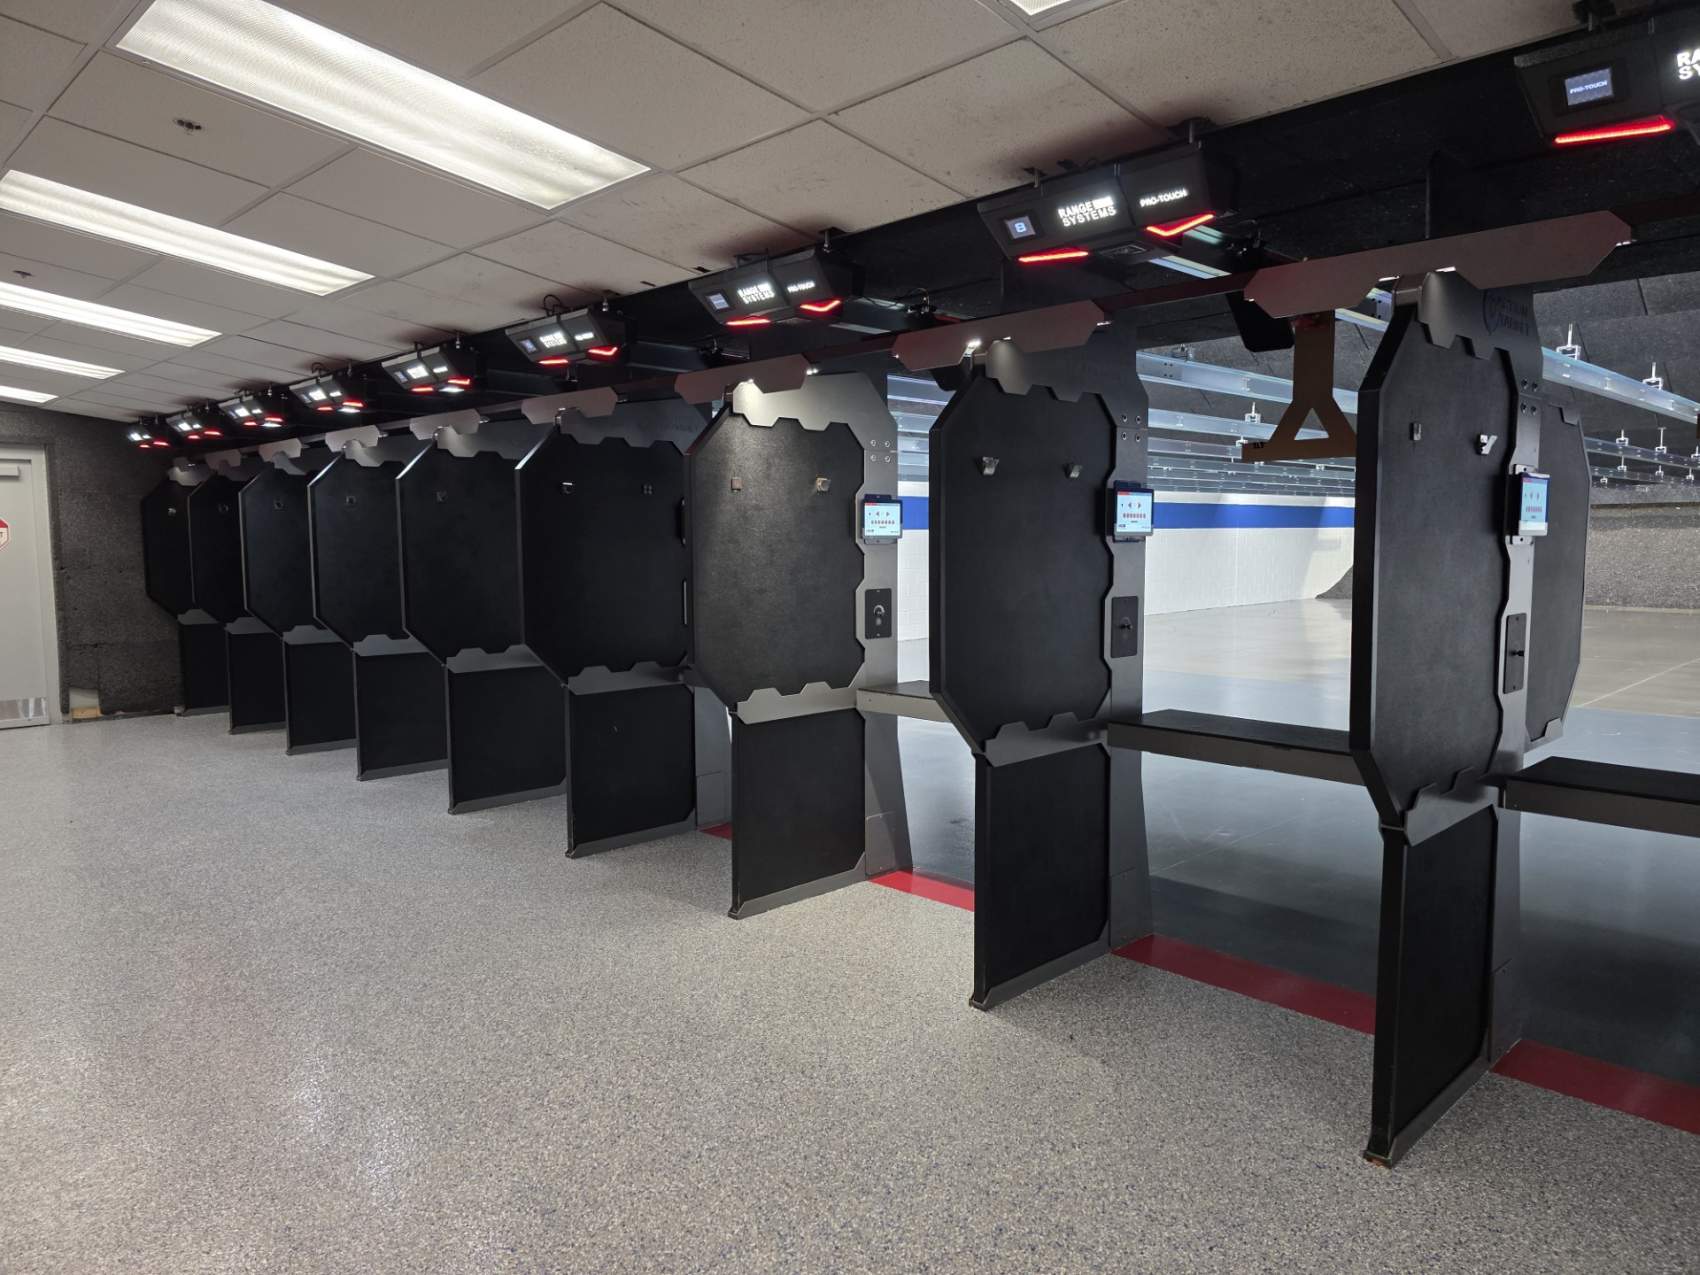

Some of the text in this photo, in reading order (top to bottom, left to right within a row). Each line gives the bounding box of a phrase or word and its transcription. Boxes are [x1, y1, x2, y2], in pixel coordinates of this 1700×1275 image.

[1139, 188, 1188, 207] PRO-TOUCH
[1058, 200, 1093, 219] RANGE
[1062, 206, 1116, 227] SYSTEMS
